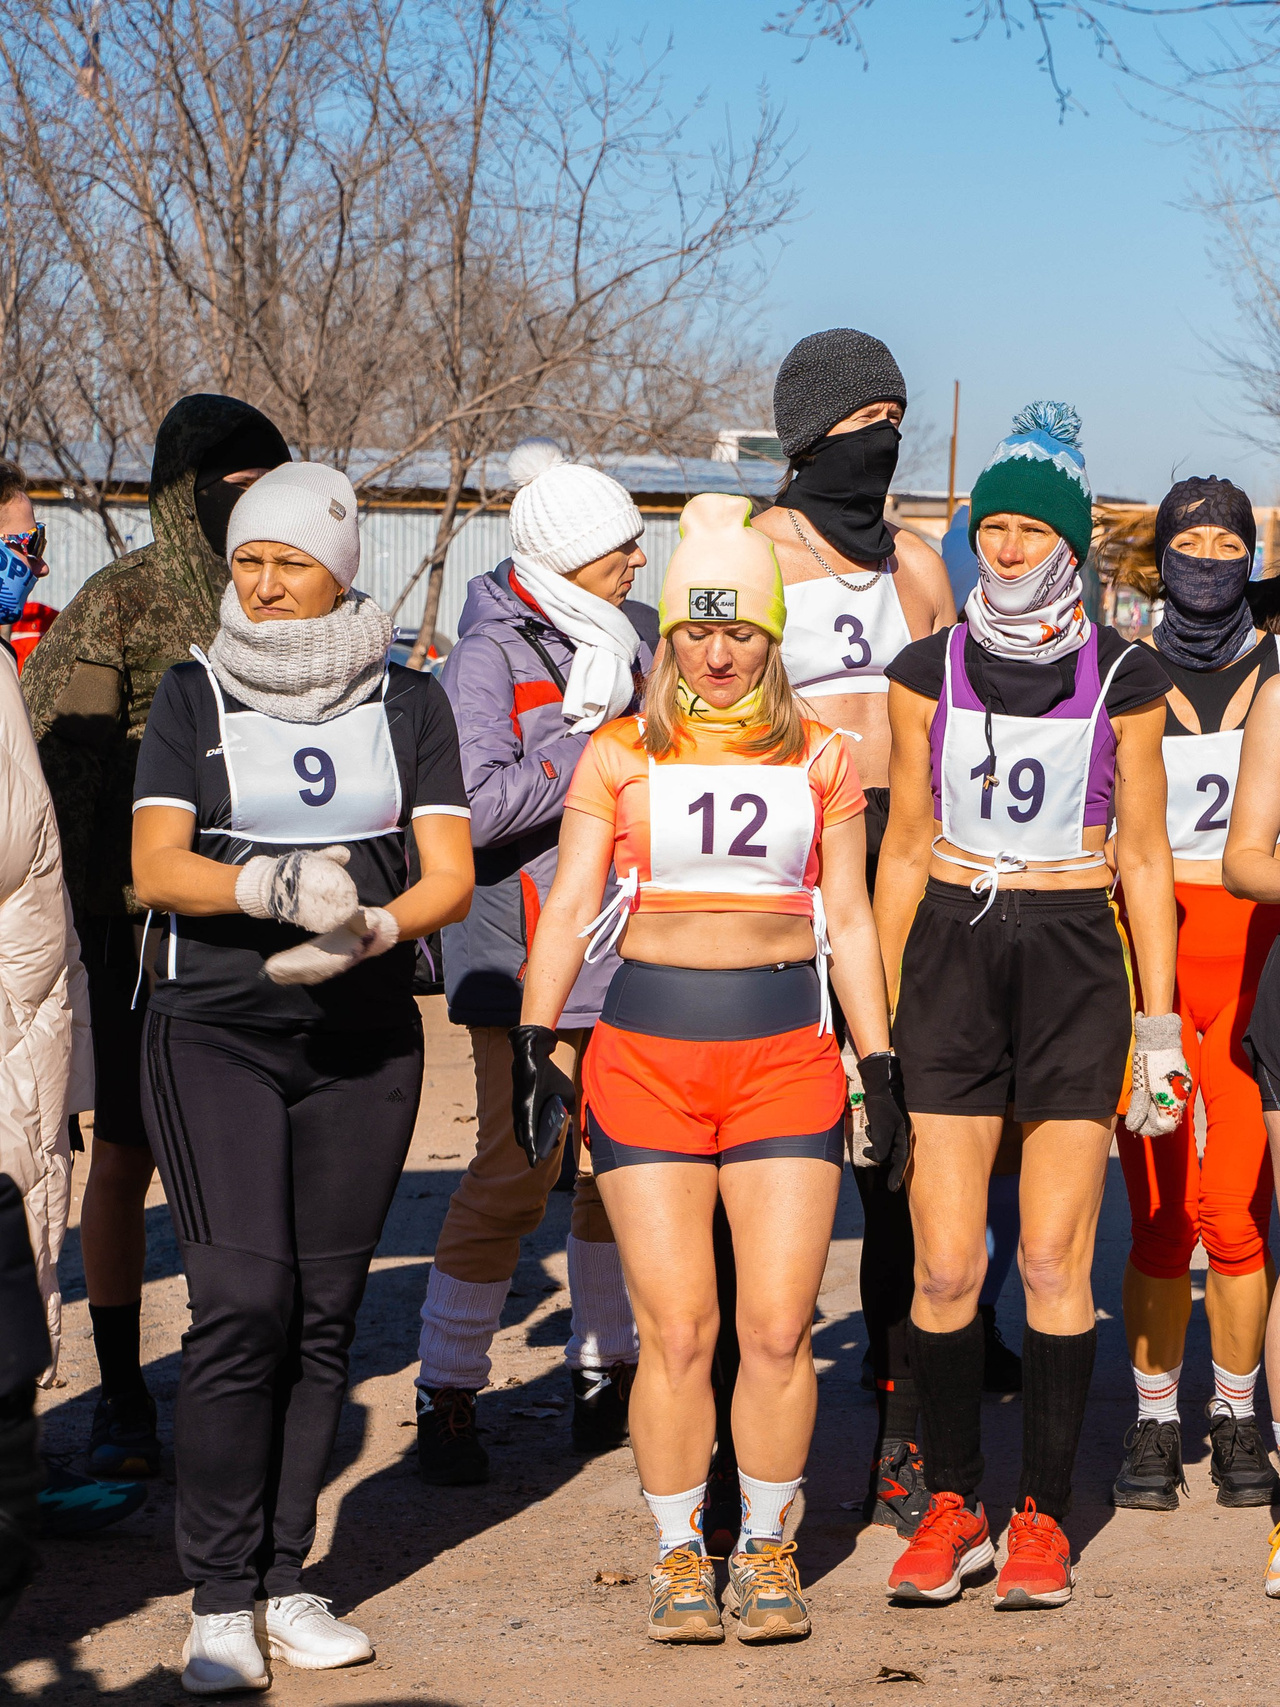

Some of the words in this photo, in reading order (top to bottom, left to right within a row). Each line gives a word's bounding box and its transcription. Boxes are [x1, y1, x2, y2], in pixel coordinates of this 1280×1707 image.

[834, 614, 872, 669] 3
[293, 747, 337, 807] 9
[970, 754, 1046, 824] 19
[1194, 773, 1230, 832] 2
[687, 791, 768, 858] 12
